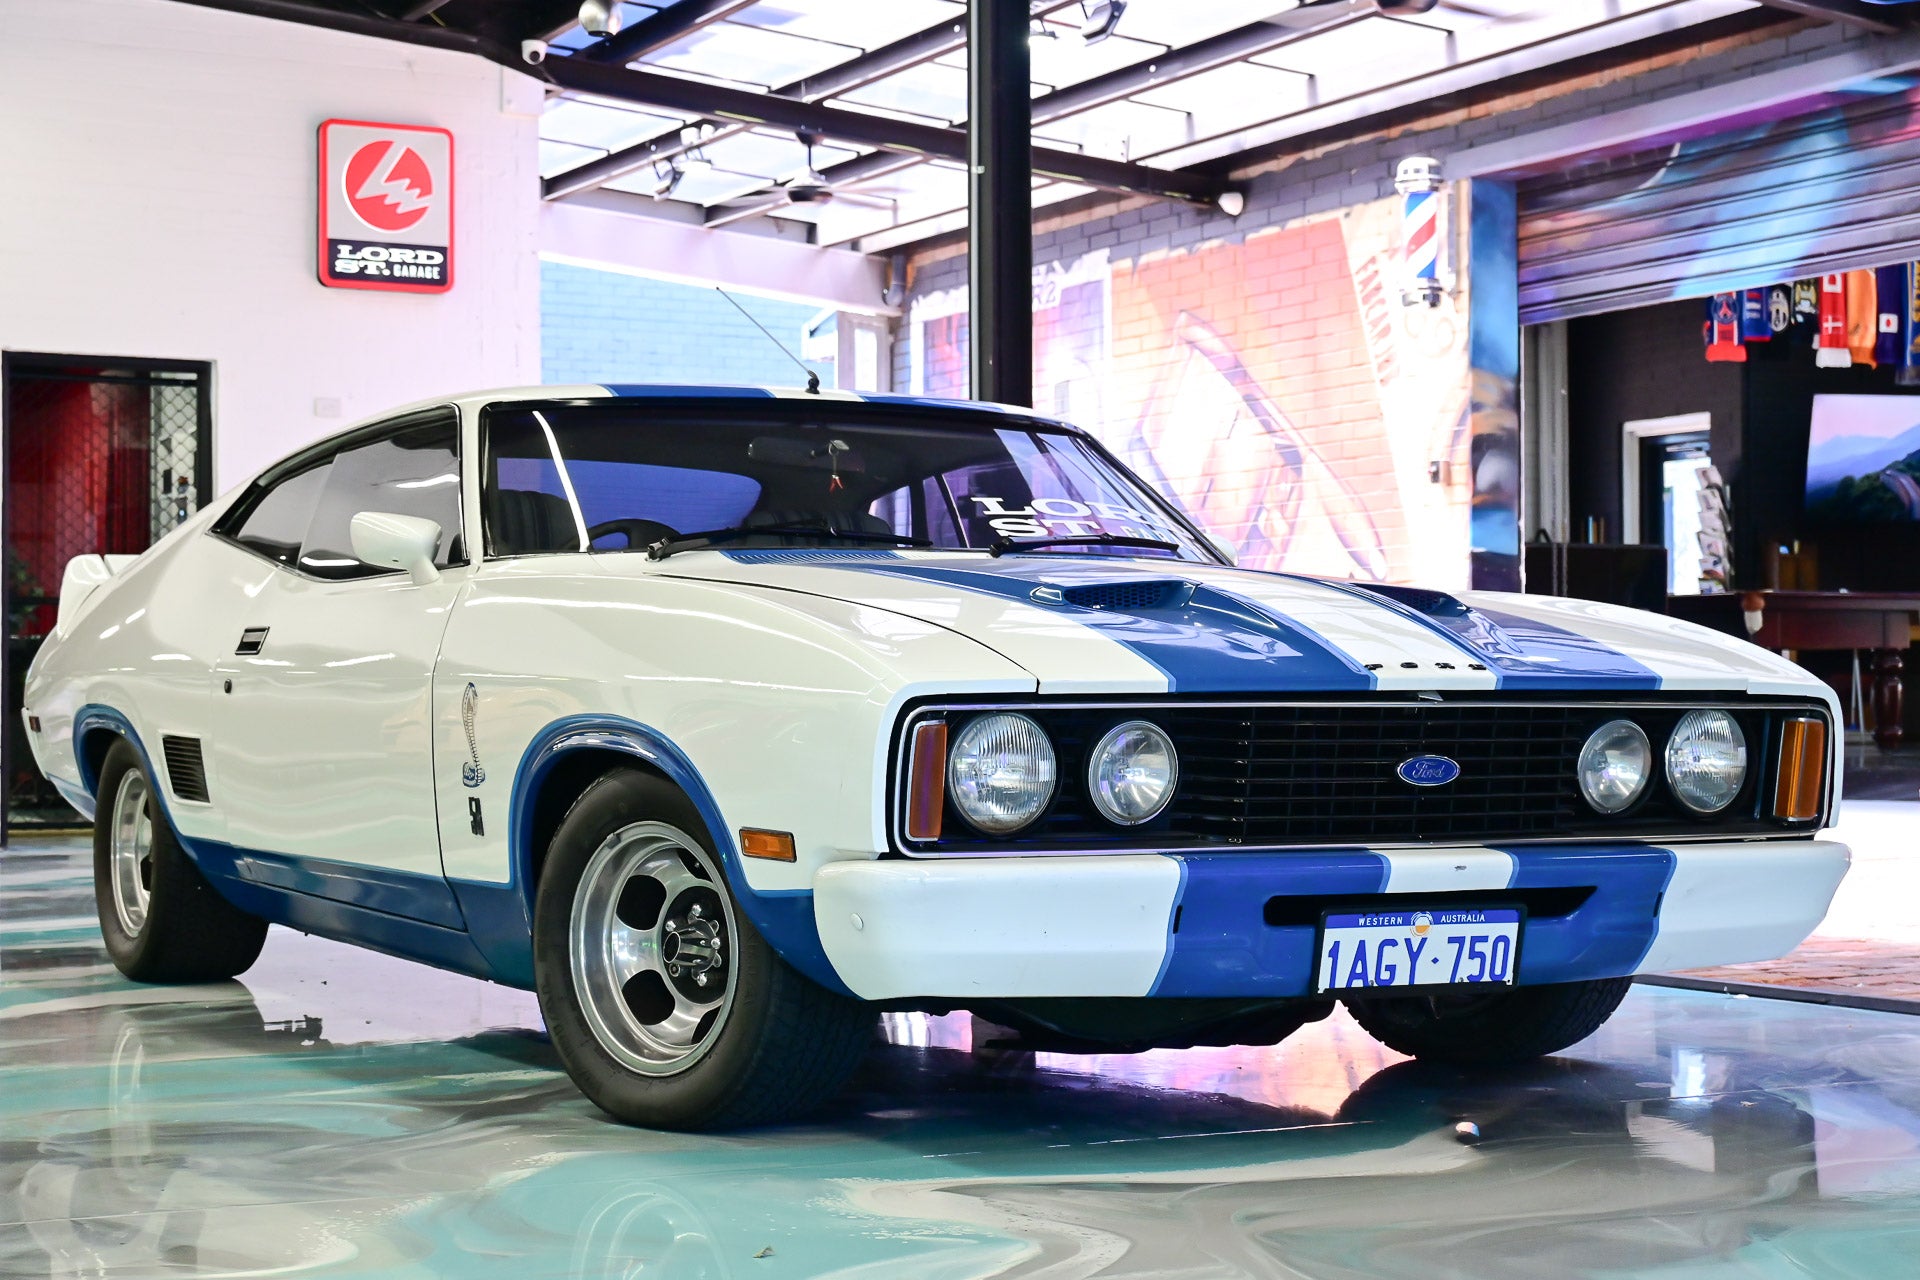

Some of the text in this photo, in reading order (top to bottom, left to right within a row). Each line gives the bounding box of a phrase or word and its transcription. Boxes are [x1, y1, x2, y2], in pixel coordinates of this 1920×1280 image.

[337, 244, 444, 265] LORD
[334, 258, 440, 280] ST. GARAGE
[1412, 760, 1446, 779] Ford
[1358, 913, 1486, 927] WESTERN AUSTRALIA
